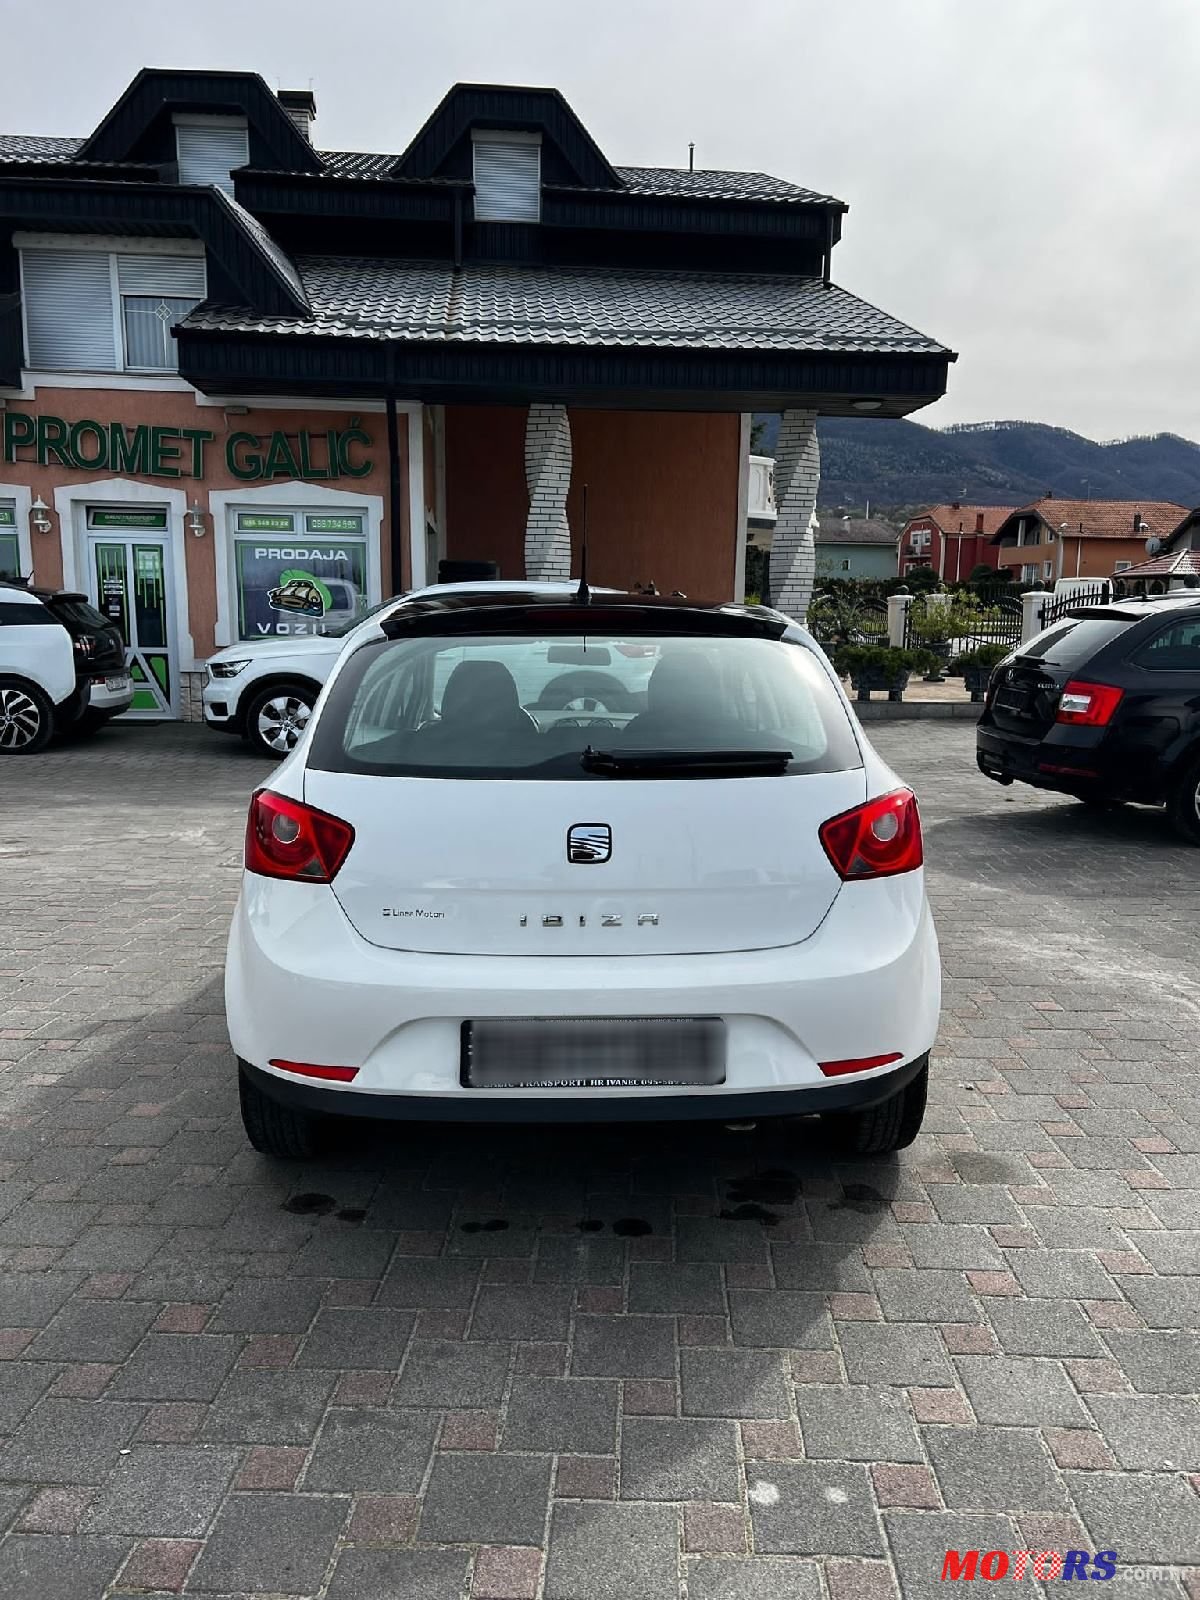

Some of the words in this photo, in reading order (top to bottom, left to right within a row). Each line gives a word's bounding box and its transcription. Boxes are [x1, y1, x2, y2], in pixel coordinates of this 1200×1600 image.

[4, 412, 214, 479] PROMET
[225, 417, 374, 480] GALIĆ
[255, 548, 348, 561] PRODAJA
[256, 622, 332, 635] VOZIL
[519, 913, 659, 927] IBIZA
